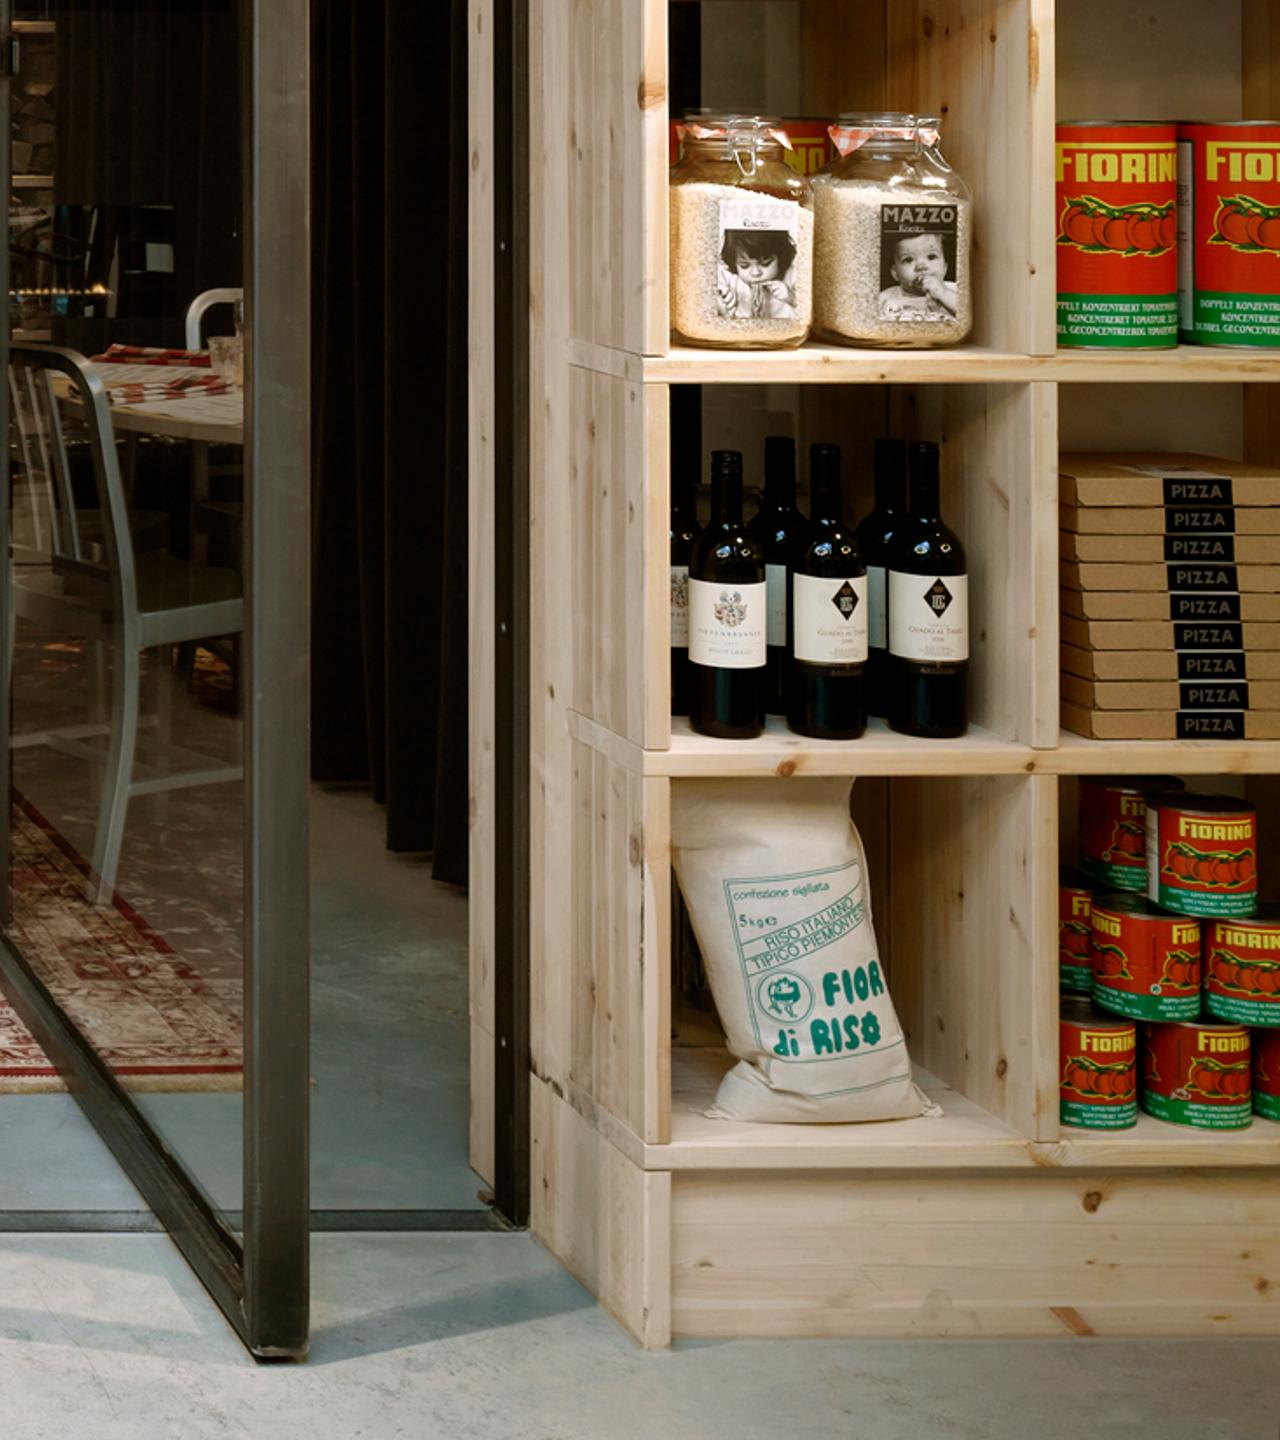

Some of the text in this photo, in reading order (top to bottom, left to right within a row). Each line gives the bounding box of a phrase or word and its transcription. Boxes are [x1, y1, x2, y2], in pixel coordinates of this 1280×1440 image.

[722, 203, 796, 222] MAZZO
[883, 206, 955, 224] MAZZO
[1171, 484, 1224, 500] PIZZA
[1174, 512, 1226, 528] PIZZA
[1172, 540, 1225, 556] PIZZA
[1176, 568, 1229, 585] PIZZA
[1179, 598, 1232, 615] PIZZA
[1183, 627, 1235, 644] PIZZA
[1186, 656, 1238, 673] PIZZA
[1188, 686, 1241, 703] PIZZA
[1184, 716, 1236, 733] PIZZA
[1178, 816, 1253, 842] FIORINO
[733, 881, 831, 902] confezione sigillata
[763, 895, 855, 951] RISO ITALIANO
[751, 945, 801, 971] TIPICO
[822, 959, 885, 1007] FIOR
[772, 1010, 882, 1057] di RISO
